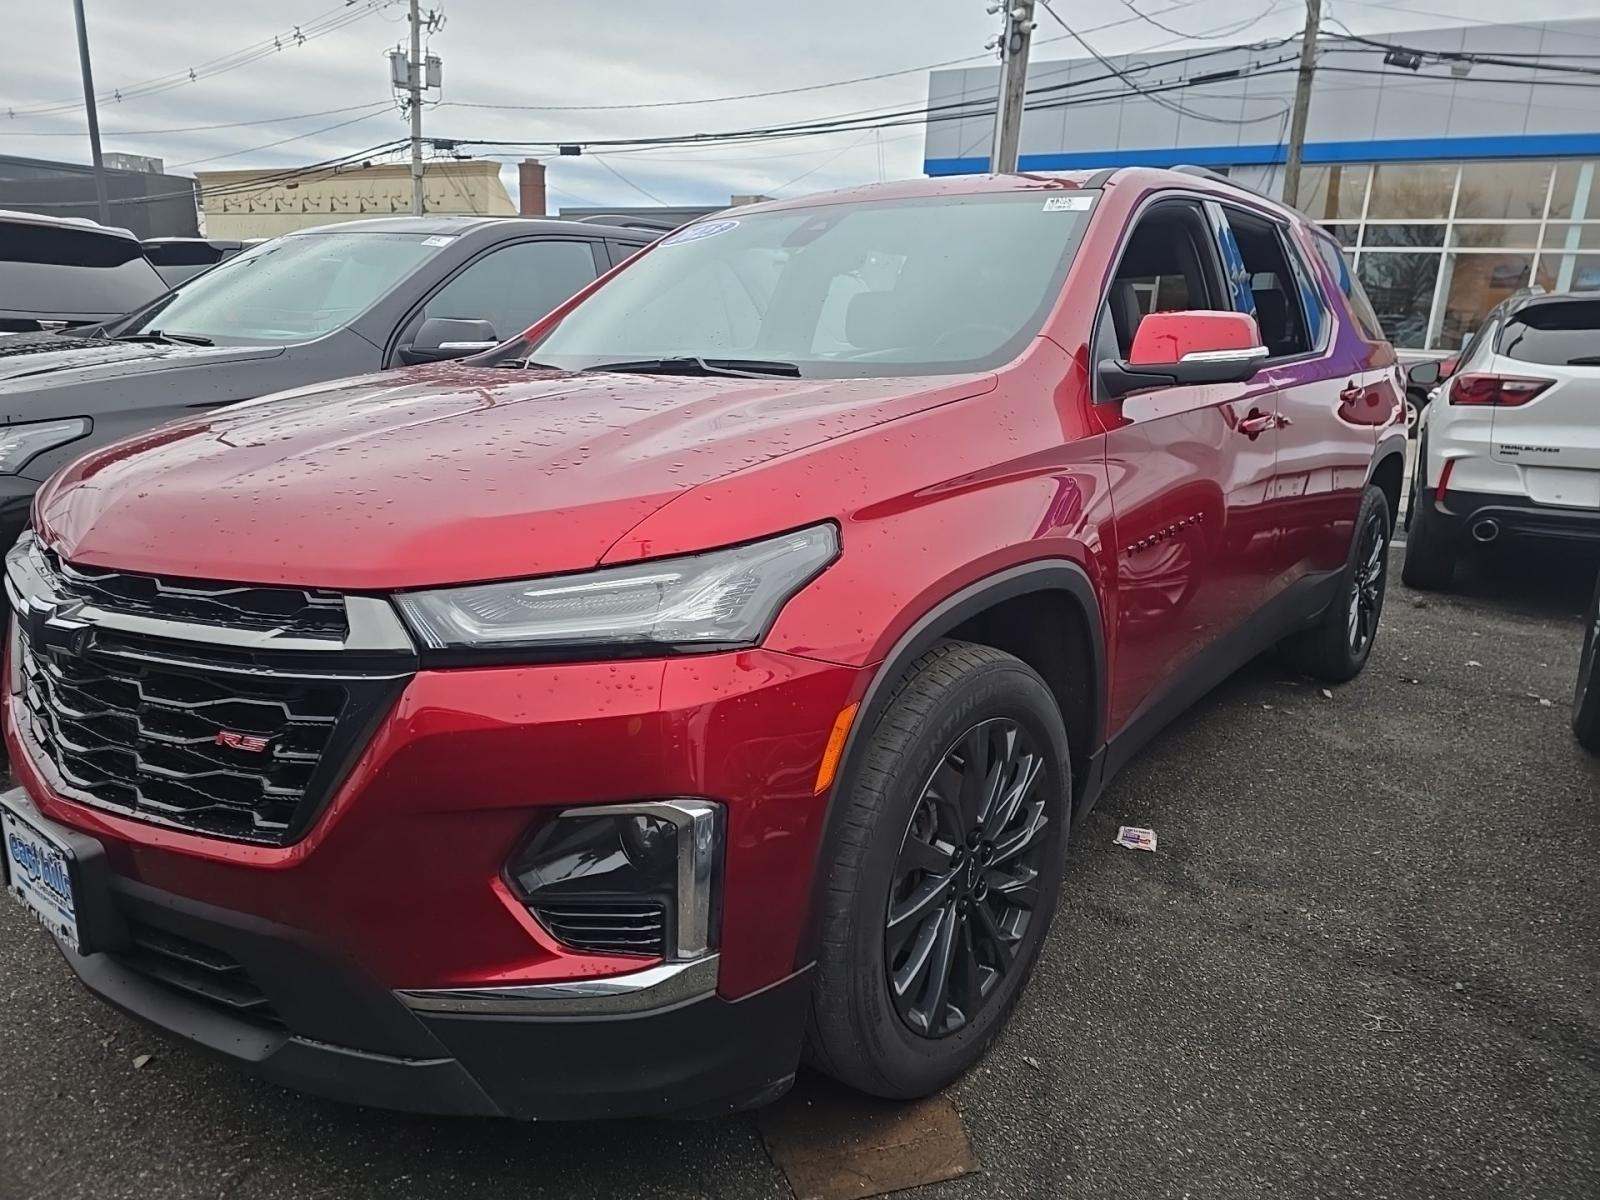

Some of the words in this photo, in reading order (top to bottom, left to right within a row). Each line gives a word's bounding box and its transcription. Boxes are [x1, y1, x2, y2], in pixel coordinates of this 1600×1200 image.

[1127, 512, 1204, 557] TRAVERSE
[214, 731, 270, 753] RS
[9, 833, 42, 882] east
